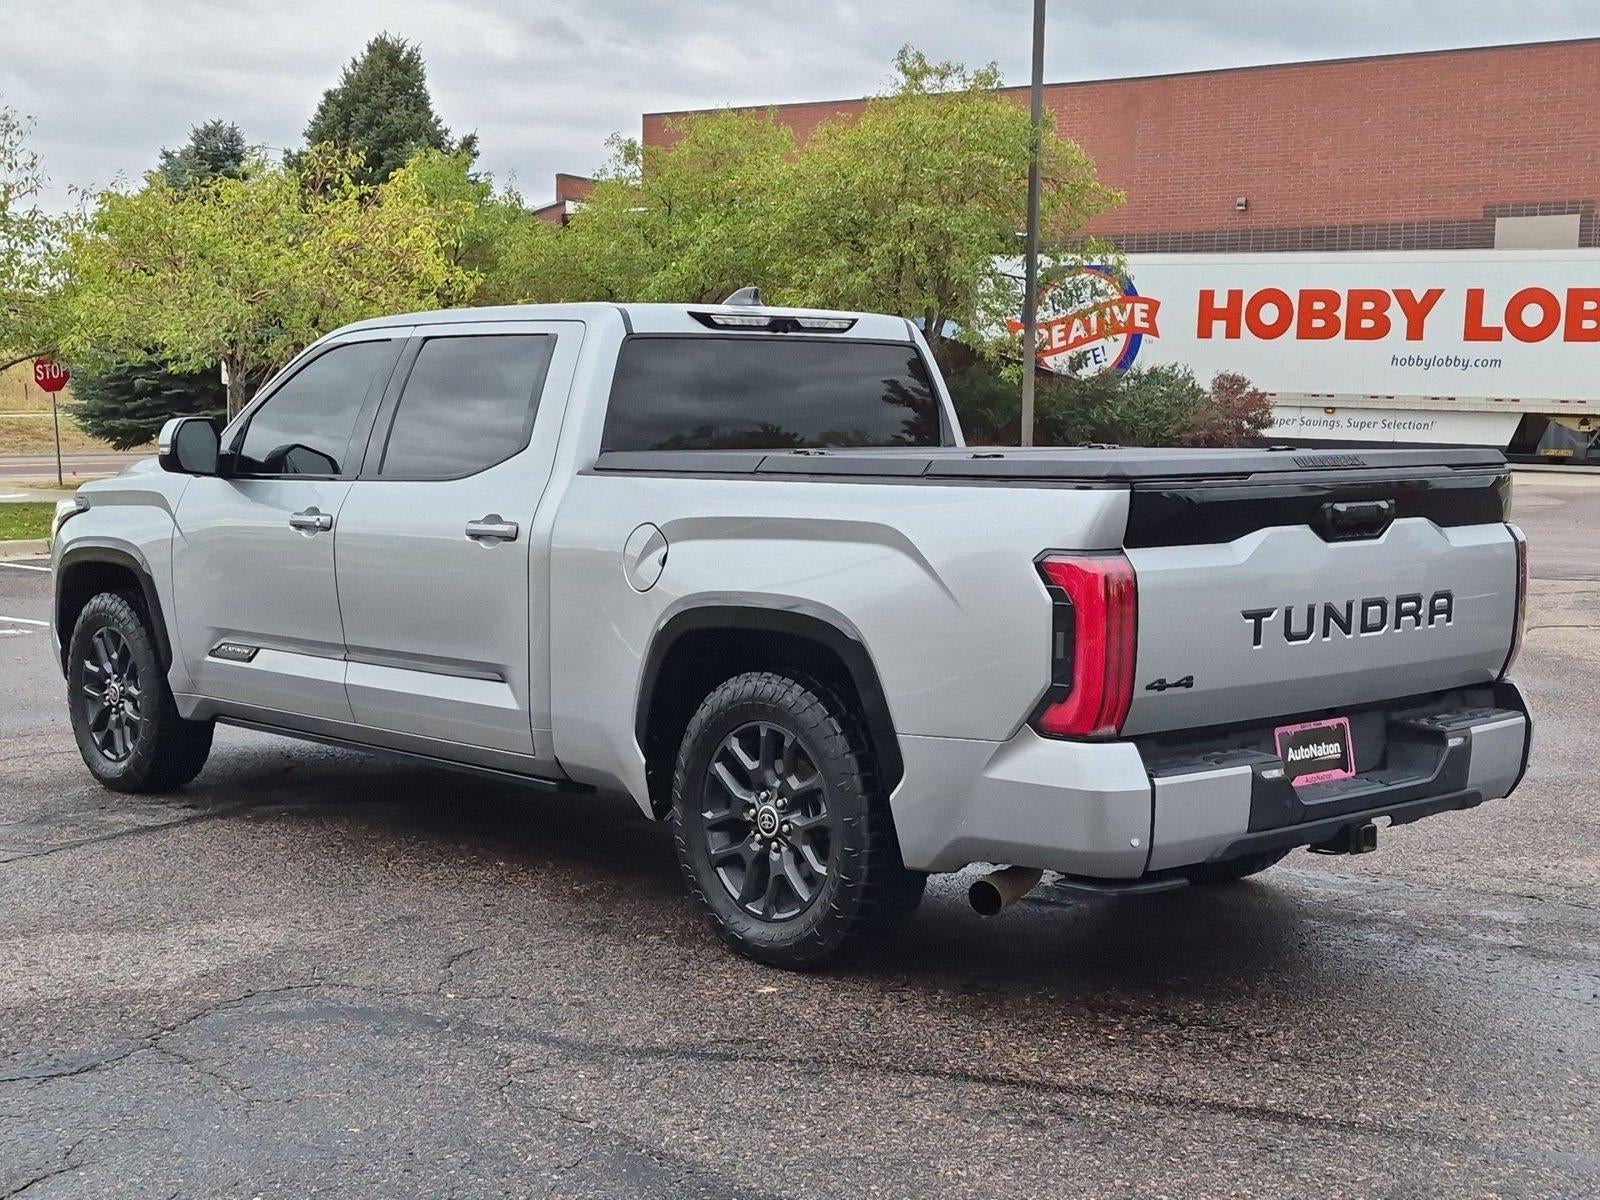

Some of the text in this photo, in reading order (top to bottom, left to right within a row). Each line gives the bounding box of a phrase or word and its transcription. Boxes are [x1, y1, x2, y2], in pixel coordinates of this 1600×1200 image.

[1020, 303, 1150, 351] REATIVE
[1197, 286, 1600, 343] HOBBY LOB
[1391, 354, 1502, 371] hobbylobby.com
[1270, 416, 1434, 431] uper Savings, Super Selection!
[1240, 589, 1454, 650] TUNDRA
[1287, 742, 1342, 762] AutoNation
